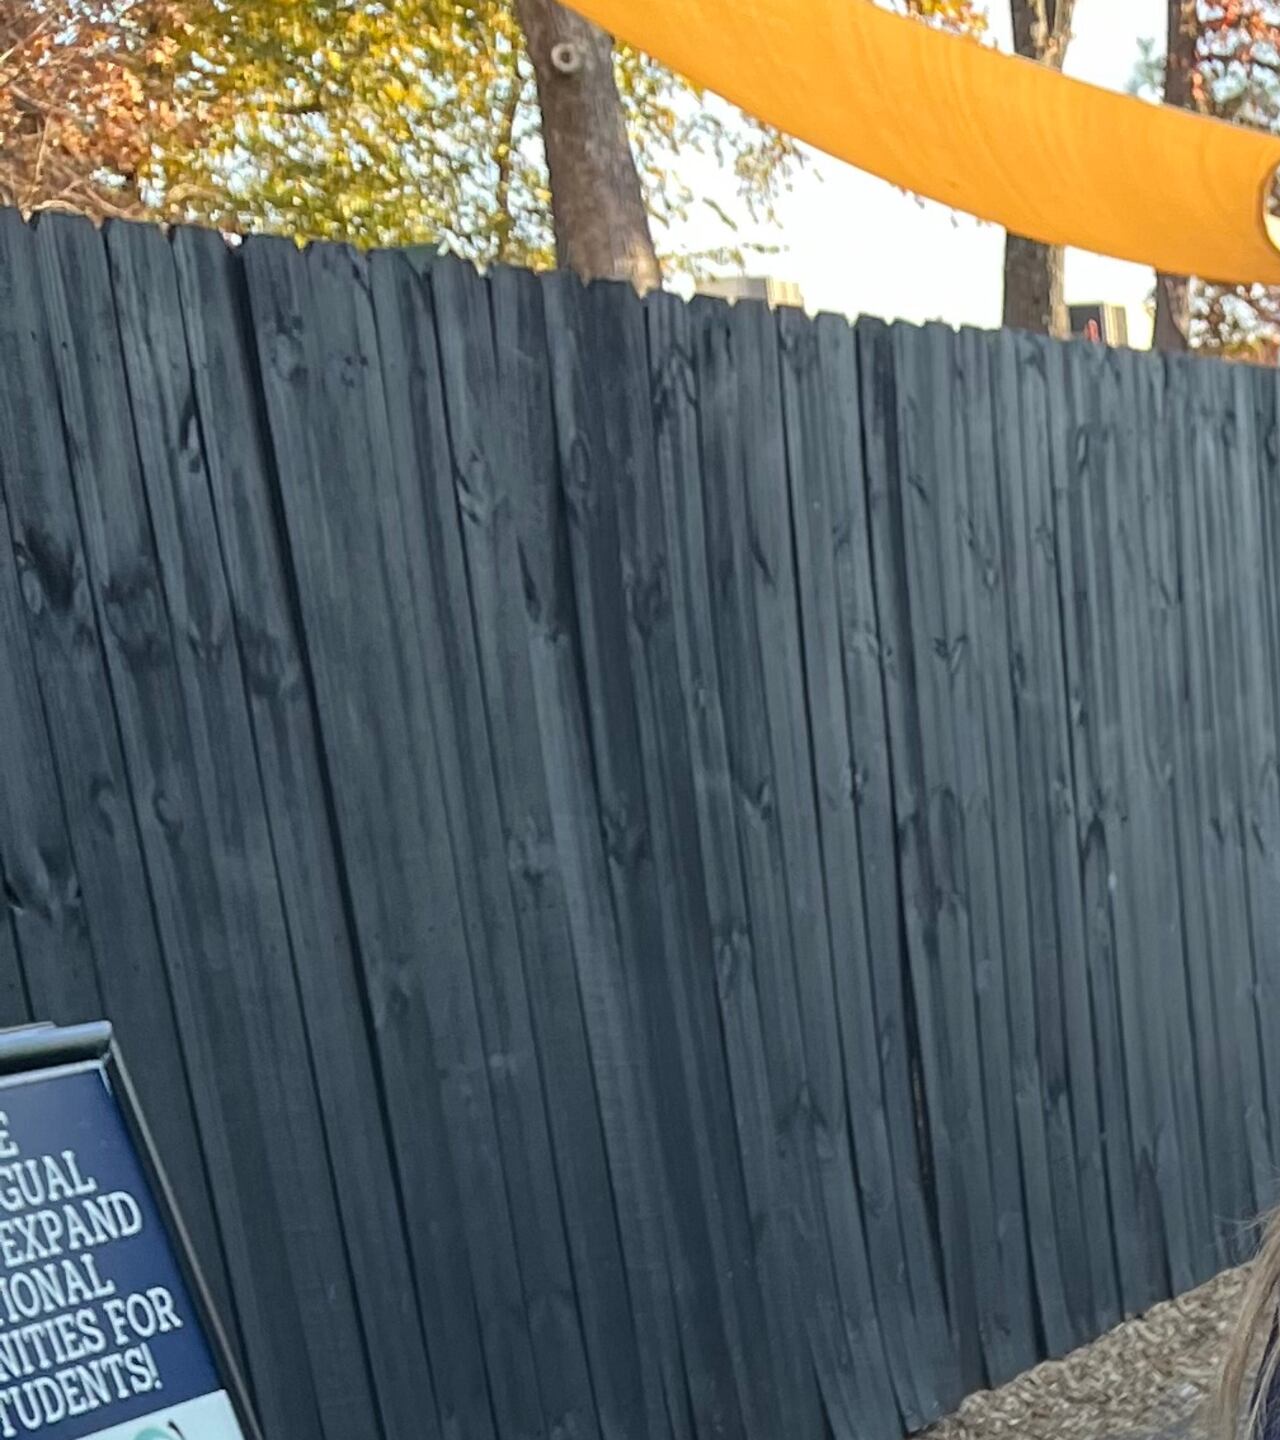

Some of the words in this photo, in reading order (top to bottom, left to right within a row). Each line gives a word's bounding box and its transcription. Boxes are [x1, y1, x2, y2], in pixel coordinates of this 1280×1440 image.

[0, 1190, 142, 1268] EXPAND
[0, 1253, 117, 1325] IONAL
[103, 1286, 183, 1347] FOR
